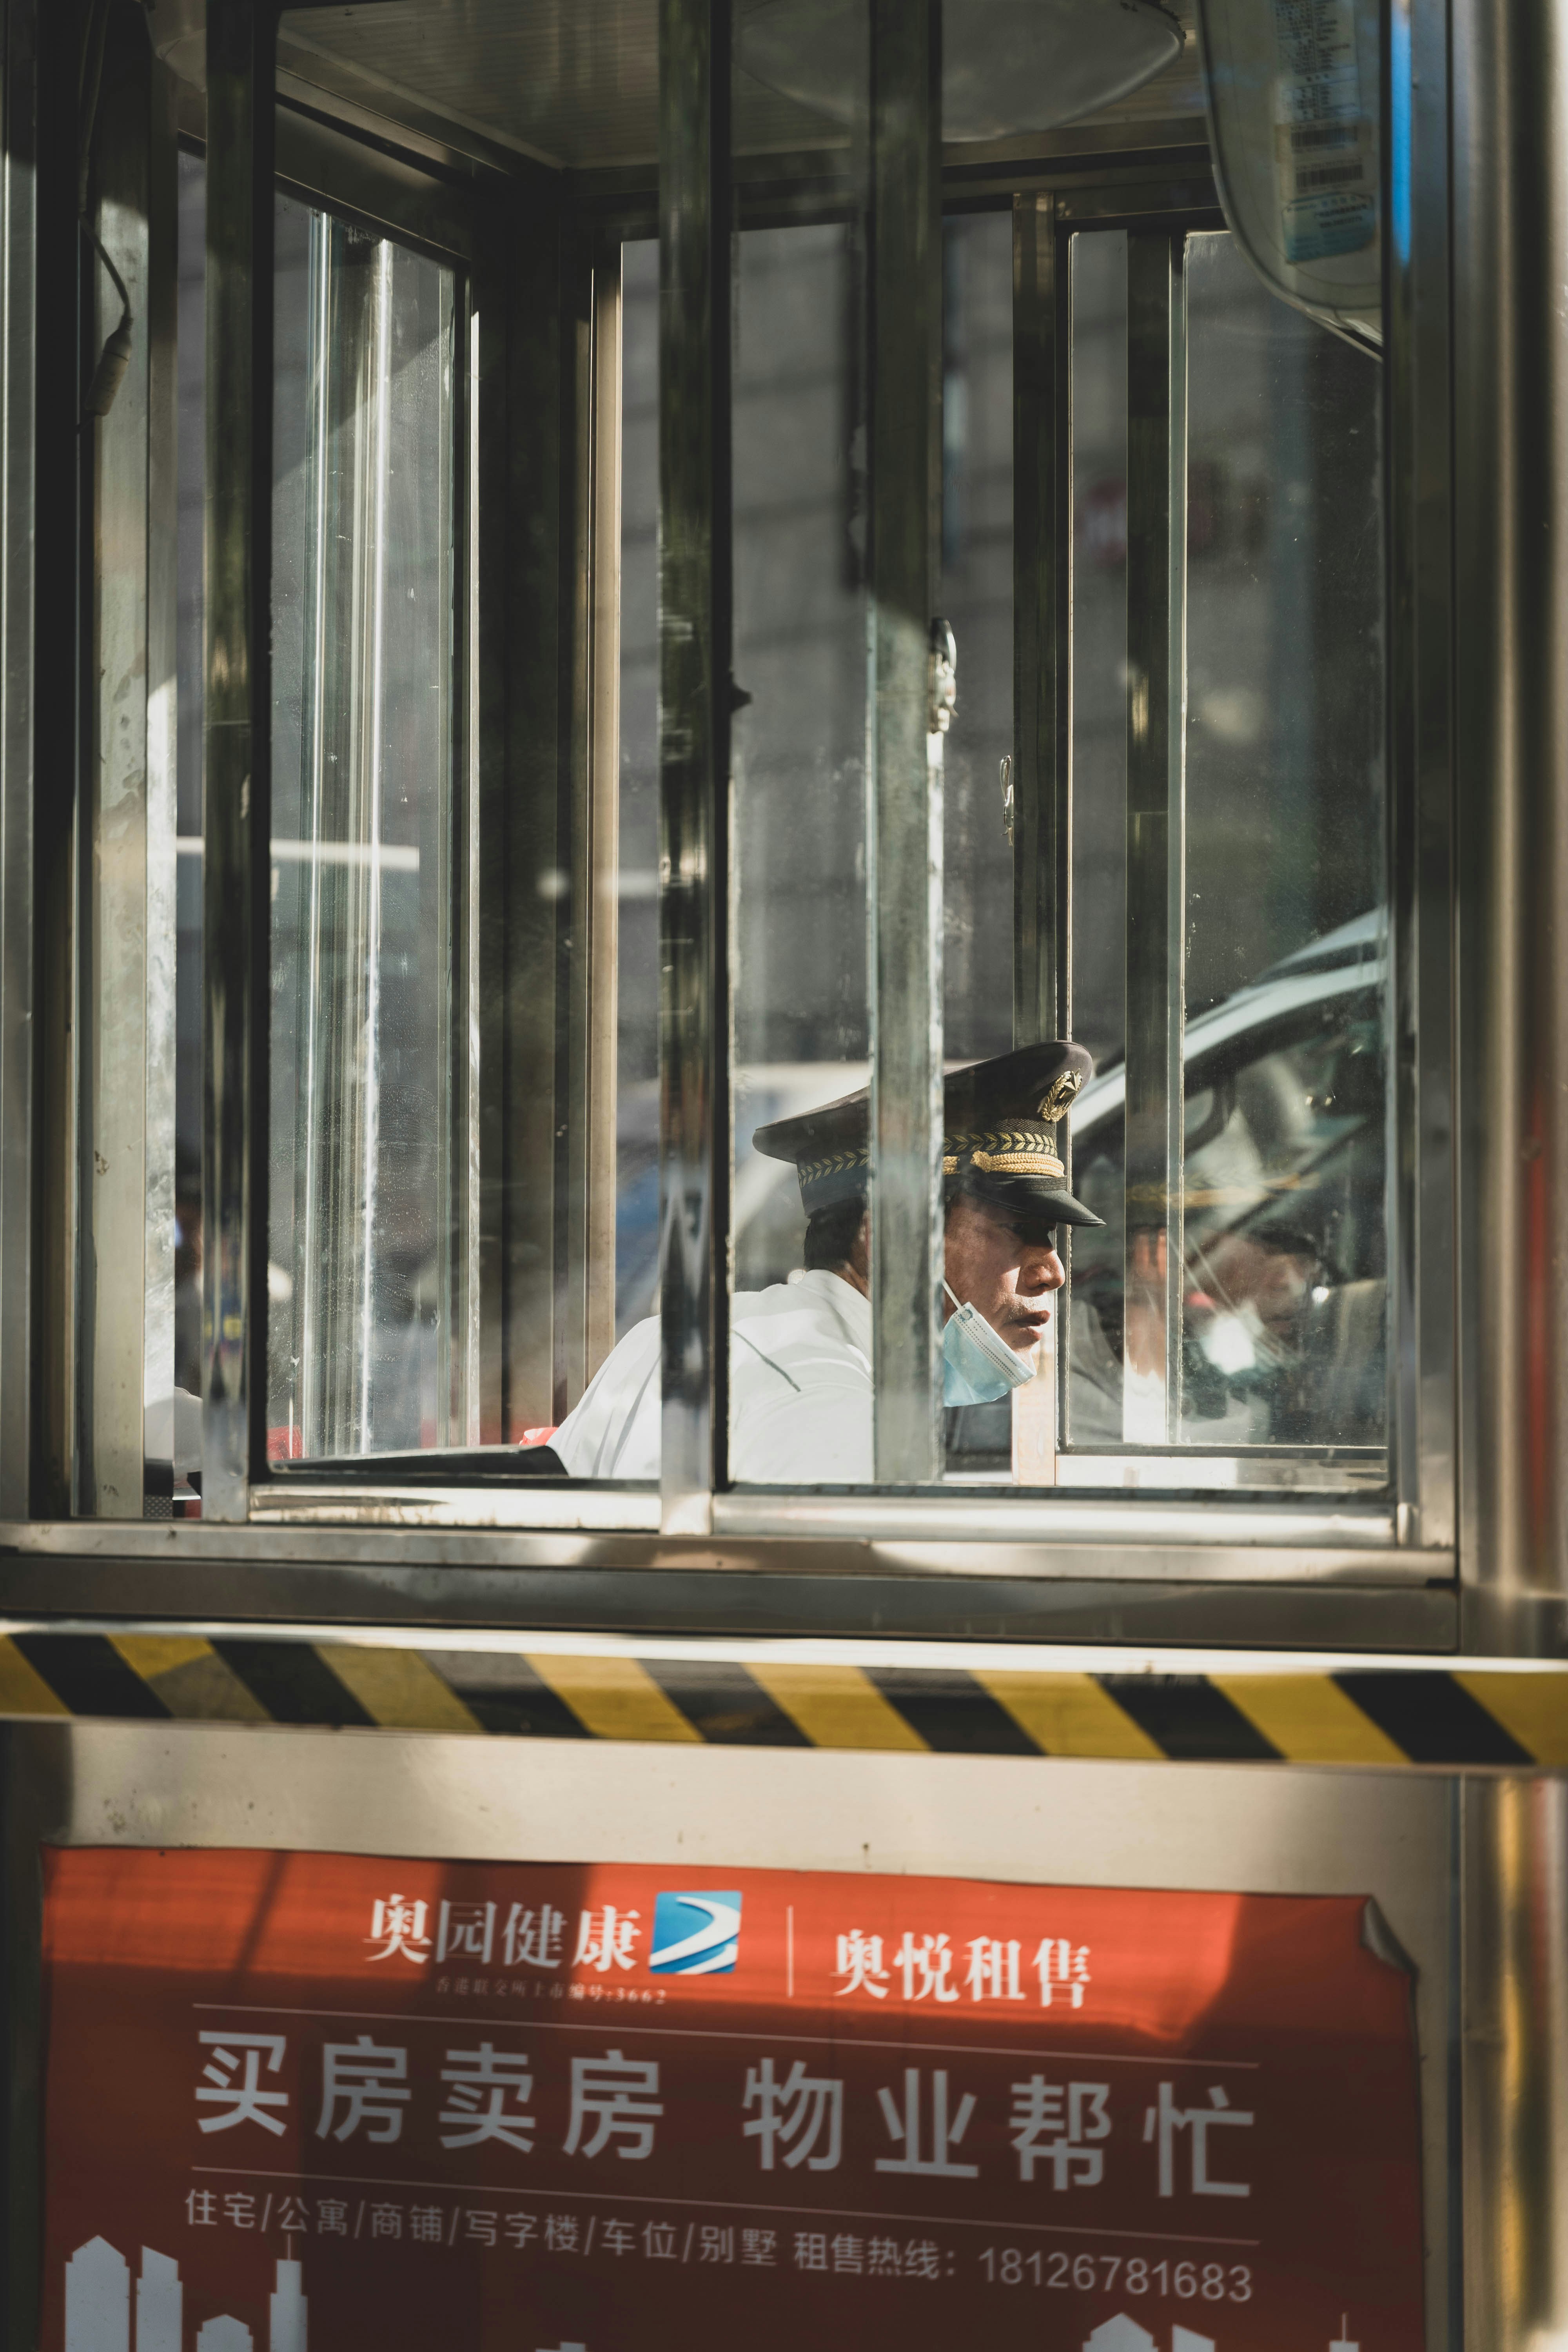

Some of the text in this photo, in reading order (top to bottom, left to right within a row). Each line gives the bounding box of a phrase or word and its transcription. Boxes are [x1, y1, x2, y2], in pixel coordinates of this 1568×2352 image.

[363, 1893, 642, 1972] 奥园健康
[830, 1929, 1091, 2008] 奥悦租售
[195, 2031, 1254, 2196] 买房卖房 物业帮忙
[979, 2248, 1252, 2302] 18126781683
